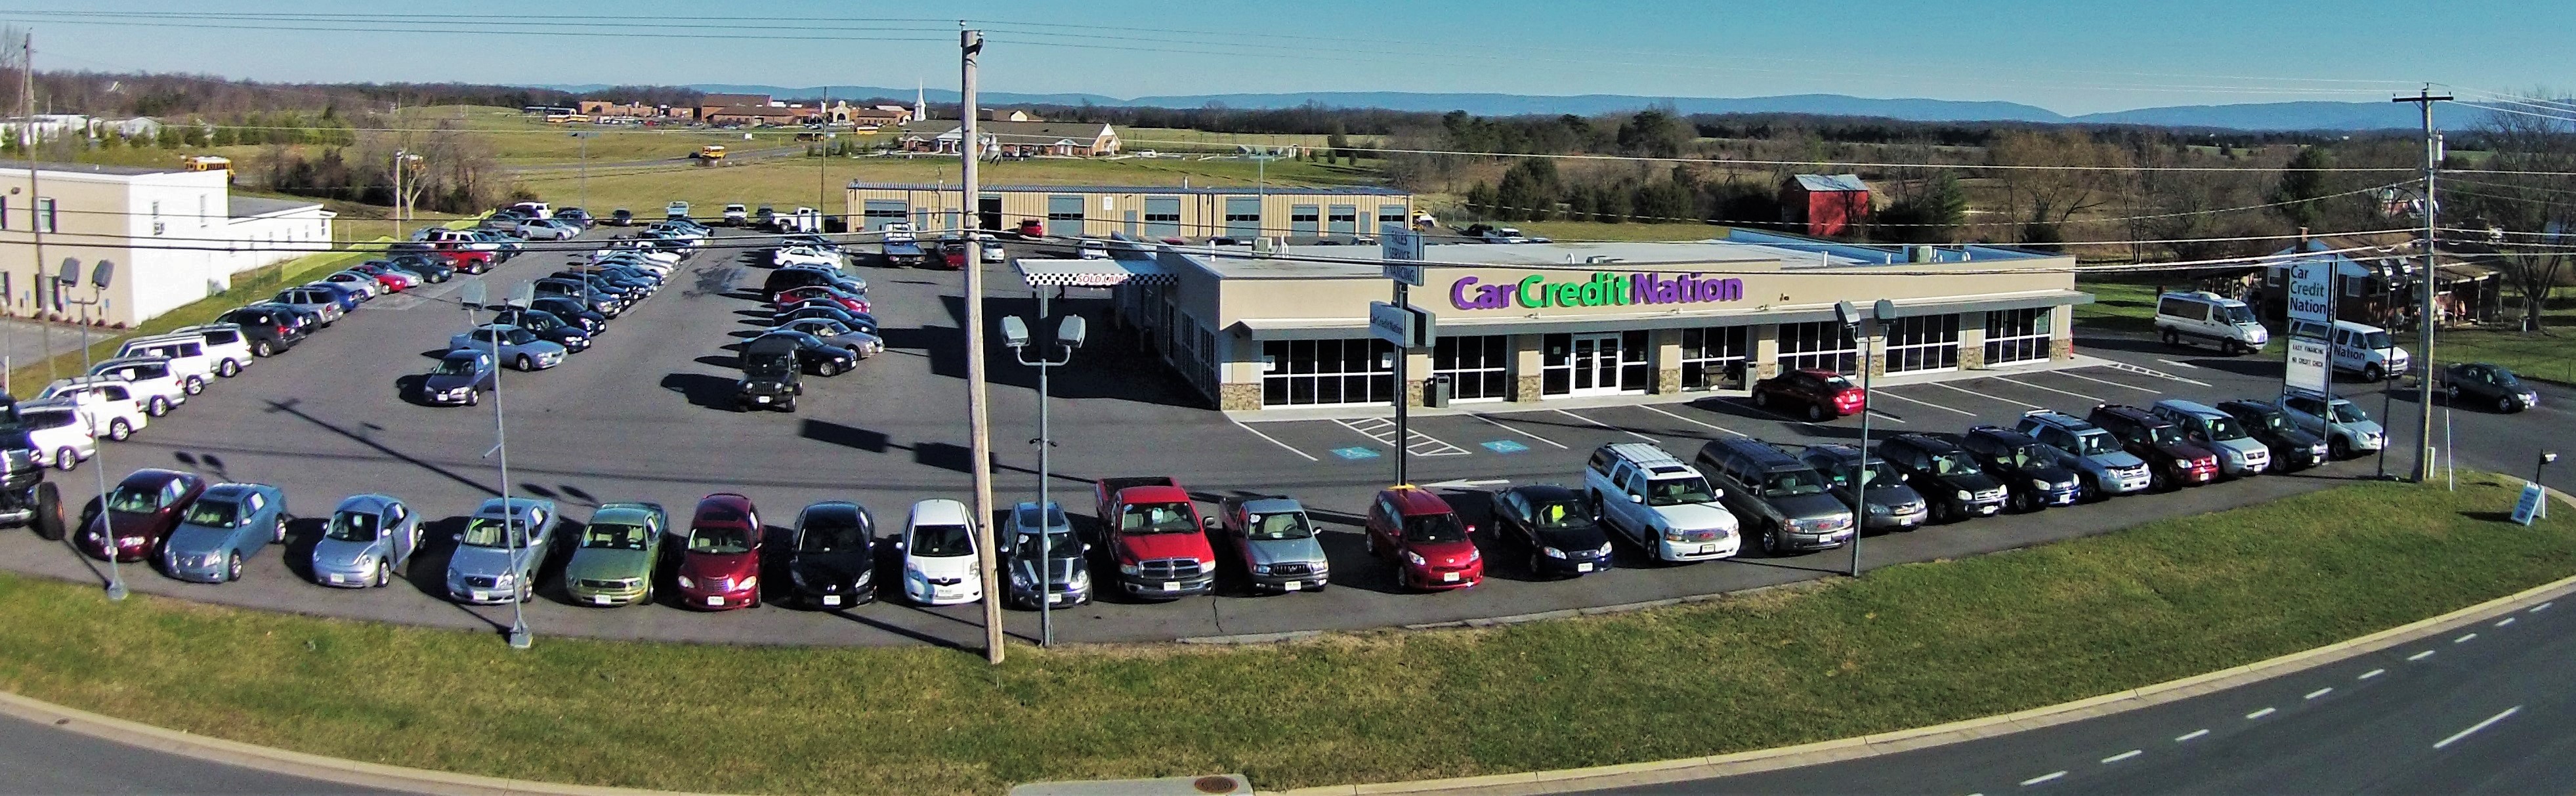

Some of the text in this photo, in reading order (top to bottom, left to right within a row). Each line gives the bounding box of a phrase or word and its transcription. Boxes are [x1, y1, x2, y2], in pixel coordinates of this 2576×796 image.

[2291, 264, 2309, 279] Car
[2290, 280, 2325, 297] Credit
[2289, 297, 2327, 314] Nation
[2334, 345, 2365, 360] Nation
